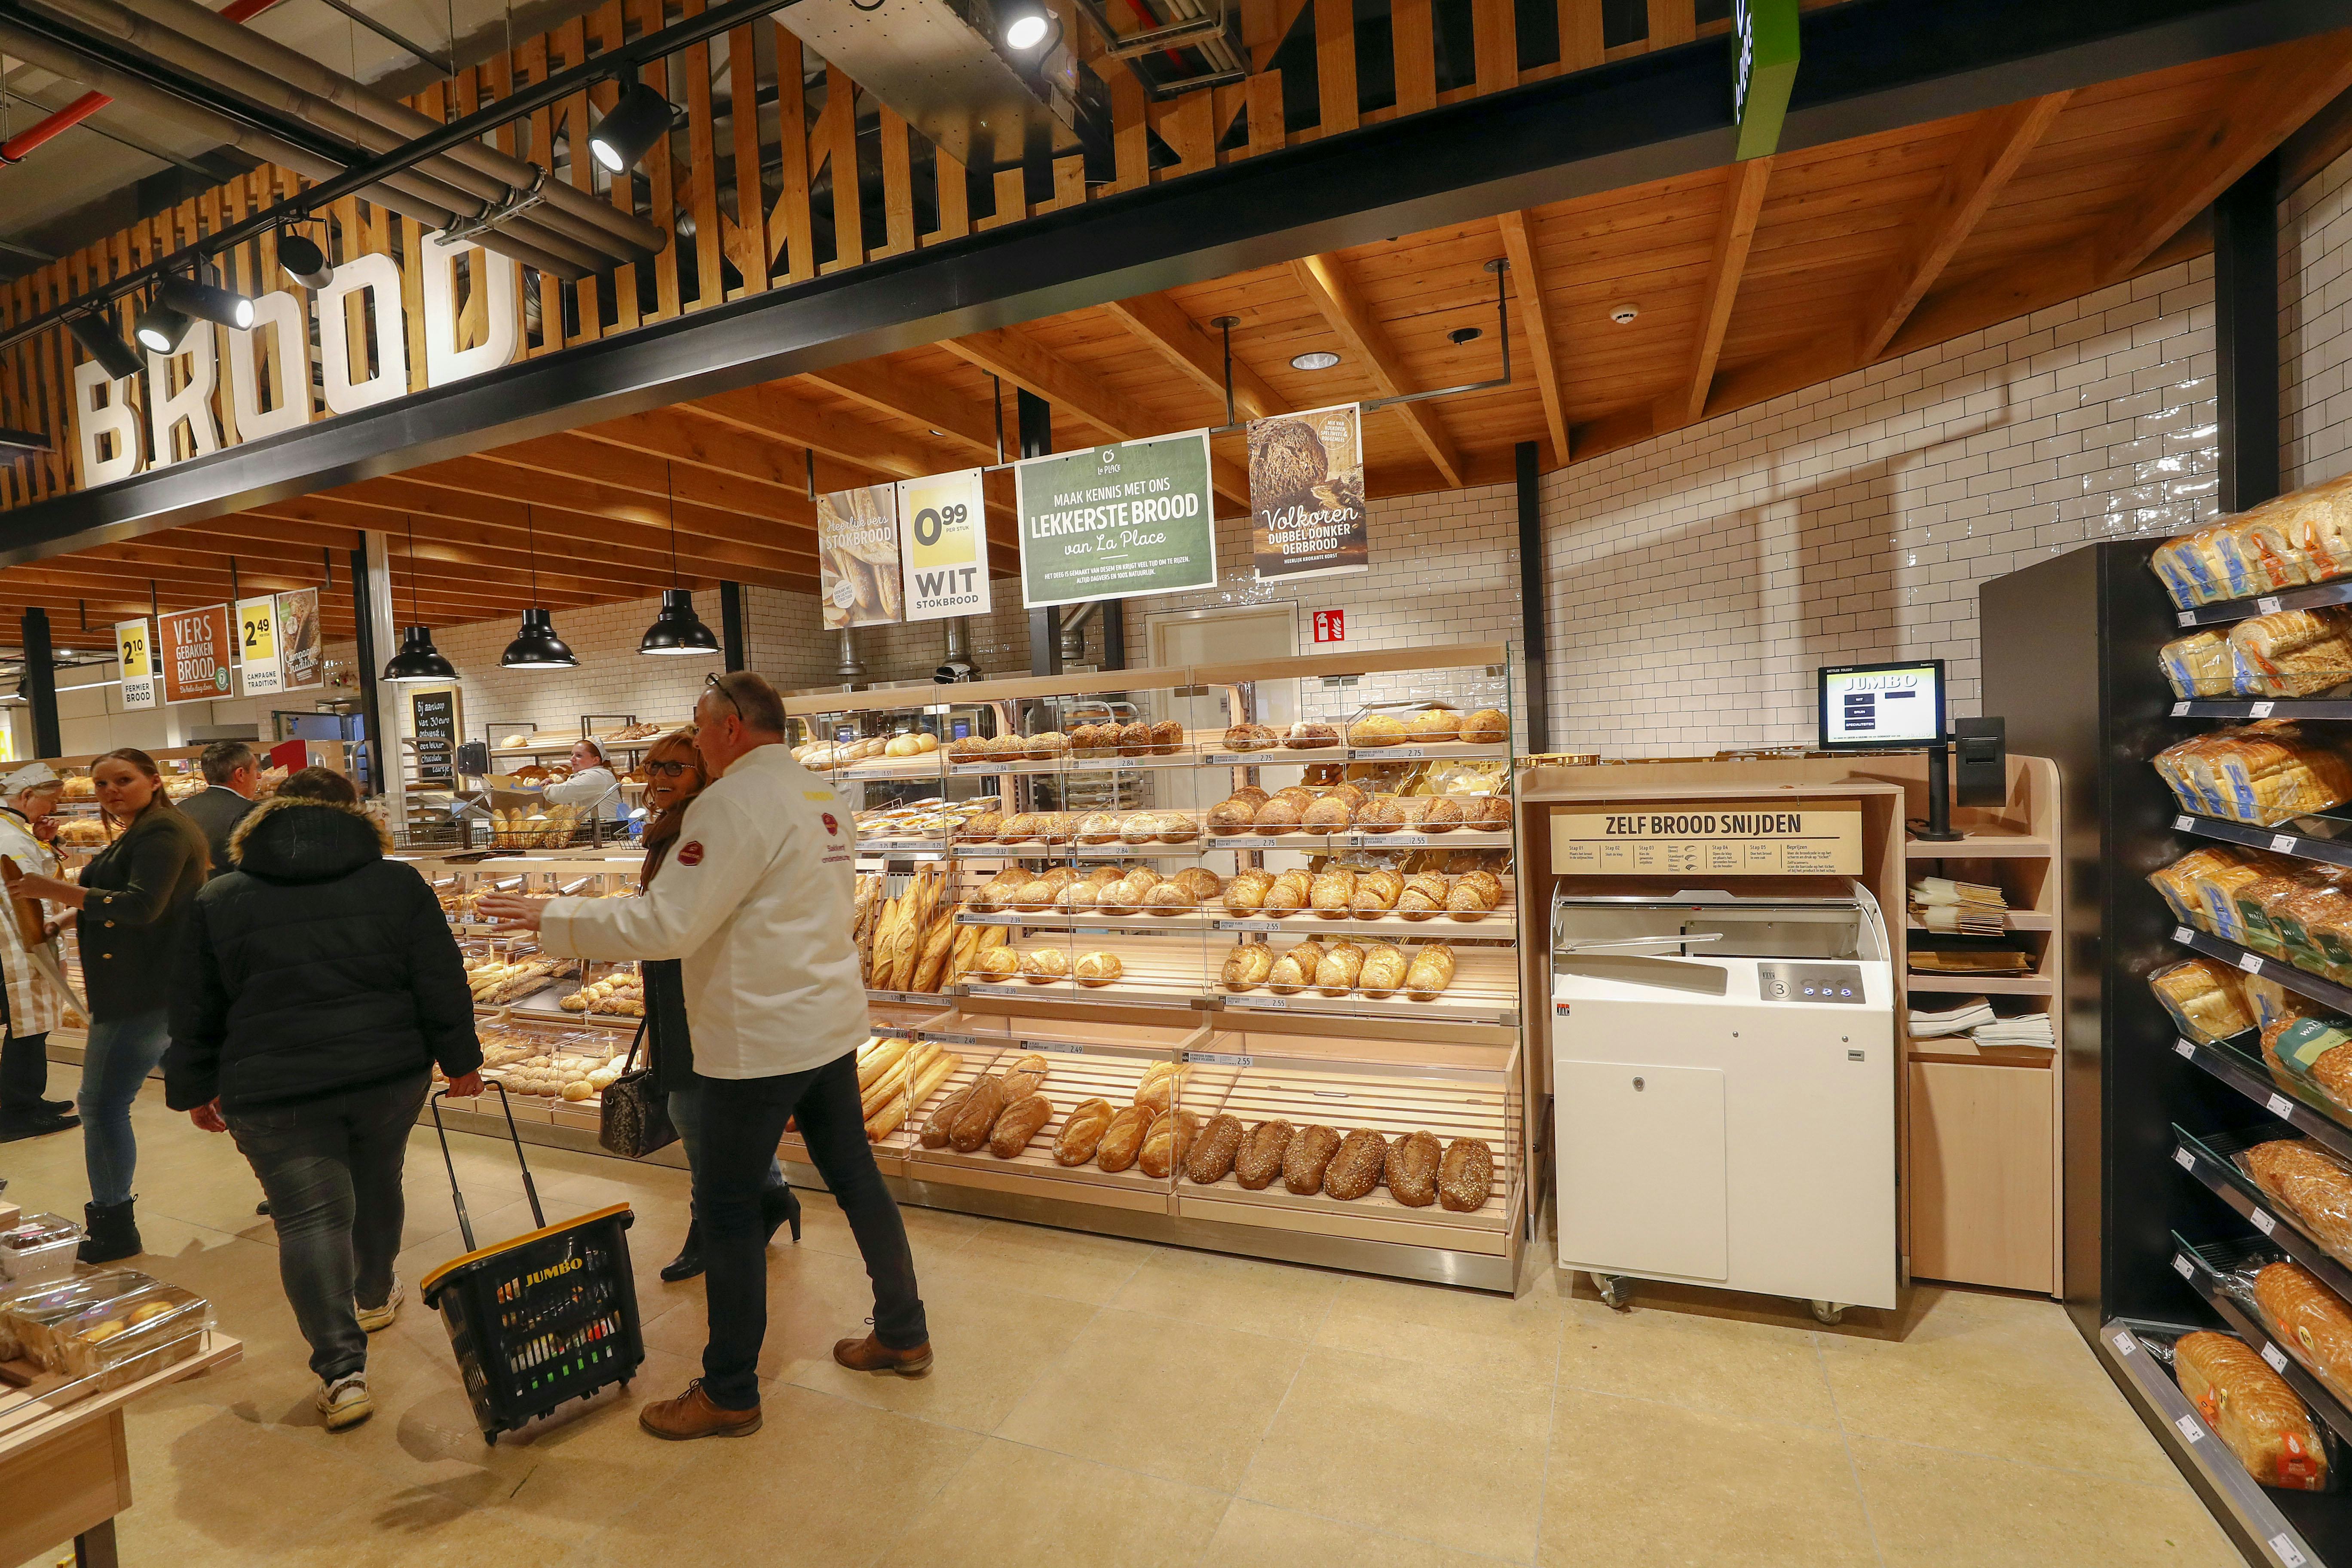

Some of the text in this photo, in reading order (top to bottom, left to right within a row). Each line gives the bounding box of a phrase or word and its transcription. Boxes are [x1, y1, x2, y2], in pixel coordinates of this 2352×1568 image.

[74, 229, 521, 489] BROOD
[1098, 464, 1121, 475] La PLACE
[1054, 477, 1170, 507] MAAK KENNIS MET ONS
[827, 515, 888, 533] Heerlijk vers
[1031, 493, 1199, 539] LEKKERSTE BROOD
[1262, 505, 1358, 532] Volkoren
[826, 526, 891, 550] STOKBROOD
[1064, 529, 1166, 555] van La Place
[1268, 523, 1351, 545] DUBBEL DONKER
[1283, 538, 1338, 555] OERBROOD
[1129, 568, 1156, 577] NATUURLIJK.
[915, 567, 977, 597] WIT
[916, 595, 979, 609] STOKBROOD
[174, 615, 212, 645] VERS
[176, 642, 213, 660] GEBAKKEN
[285, 646, 318, 663] Campagne
[177, 657, 215, 681] BROOD
[288, 658, 318, 674] Tradition
[247, 671, 276, 680] CAMPAGNE
[248, 679, 277, 688] TRADITION
[1844, 674, 1917, 691] JUMBO
[126, 683, 149, 692] FERMIER
[127, 692, 150, 702] BROOD
[424, 701, 444, 711] aankoop
[430, 717, 438, 727] 30
[421, 754, 442, 764] chocolade
[1606, 814, 1801, 836] ZELF BROOD SNIJDEN
[1763, 971, 1775, 980] JAC
[1776, 983, 1785, 994] 3
[1557, 1007, 1569, 1016] JAC
[526, 1258, 582, 1287] JUMBO
